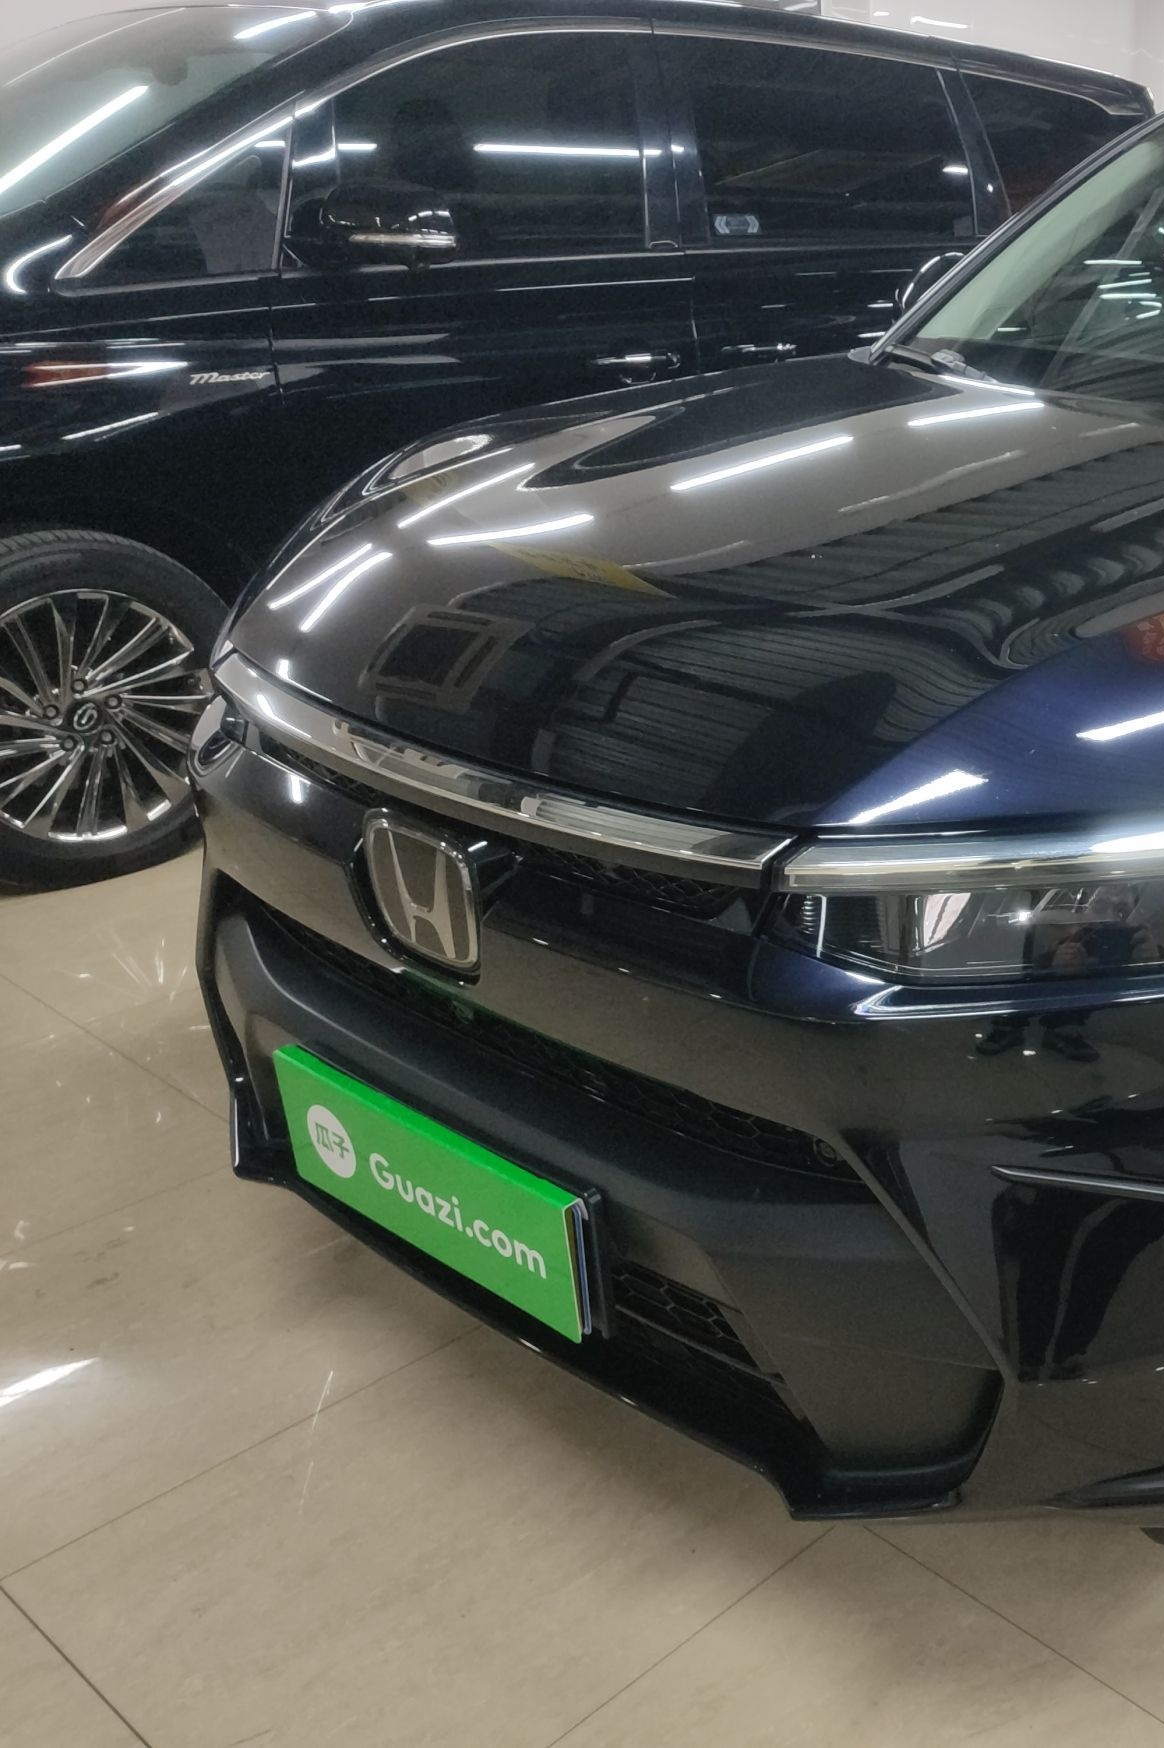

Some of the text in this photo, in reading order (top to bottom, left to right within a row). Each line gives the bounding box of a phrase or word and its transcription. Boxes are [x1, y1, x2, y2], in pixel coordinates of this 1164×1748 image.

[189, 371, 272, 386] Master
[314, 1121, 351, 1160] 瓜子
[368, 1152, 548, 1280] Guazi.com
